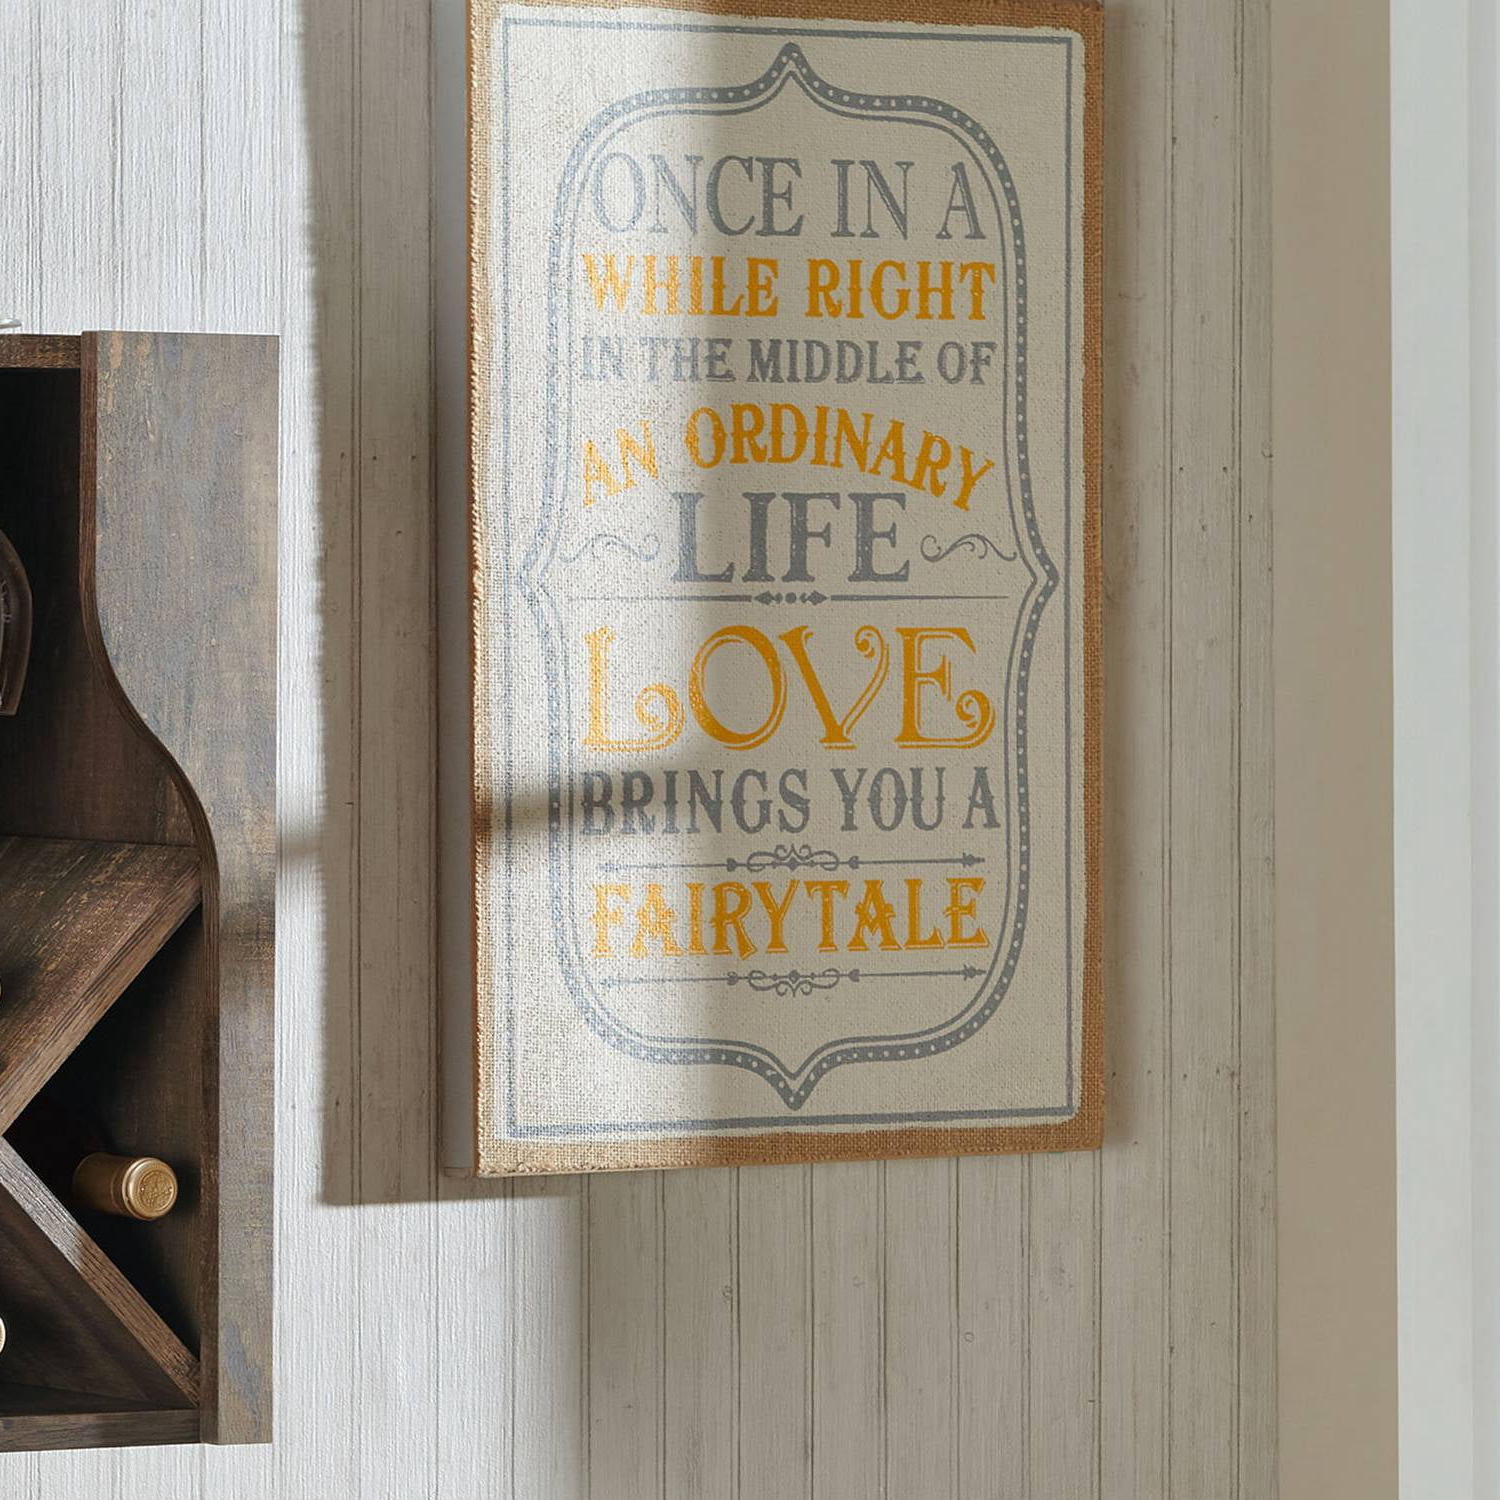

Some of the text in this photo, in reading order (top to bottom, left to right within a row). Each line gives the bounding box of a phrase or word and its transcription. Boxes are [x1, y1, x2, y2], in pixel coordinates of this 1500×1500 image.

[593, 152, 986, 241] ONCE IN A
[581, 252, 996, 321] WHILE RIGHT
[580, 336, 997, 386] IN THE MIDDLE OF
[579, 402, 996, 513] AN ORDINARY
[670, 489, 913, 584] LIFE
[581, 624, 997, 752] LOVE
[579, 766, 1000, 837] BRINGS YOU A
[591, 877, 991, 961] FAIRYTALE
